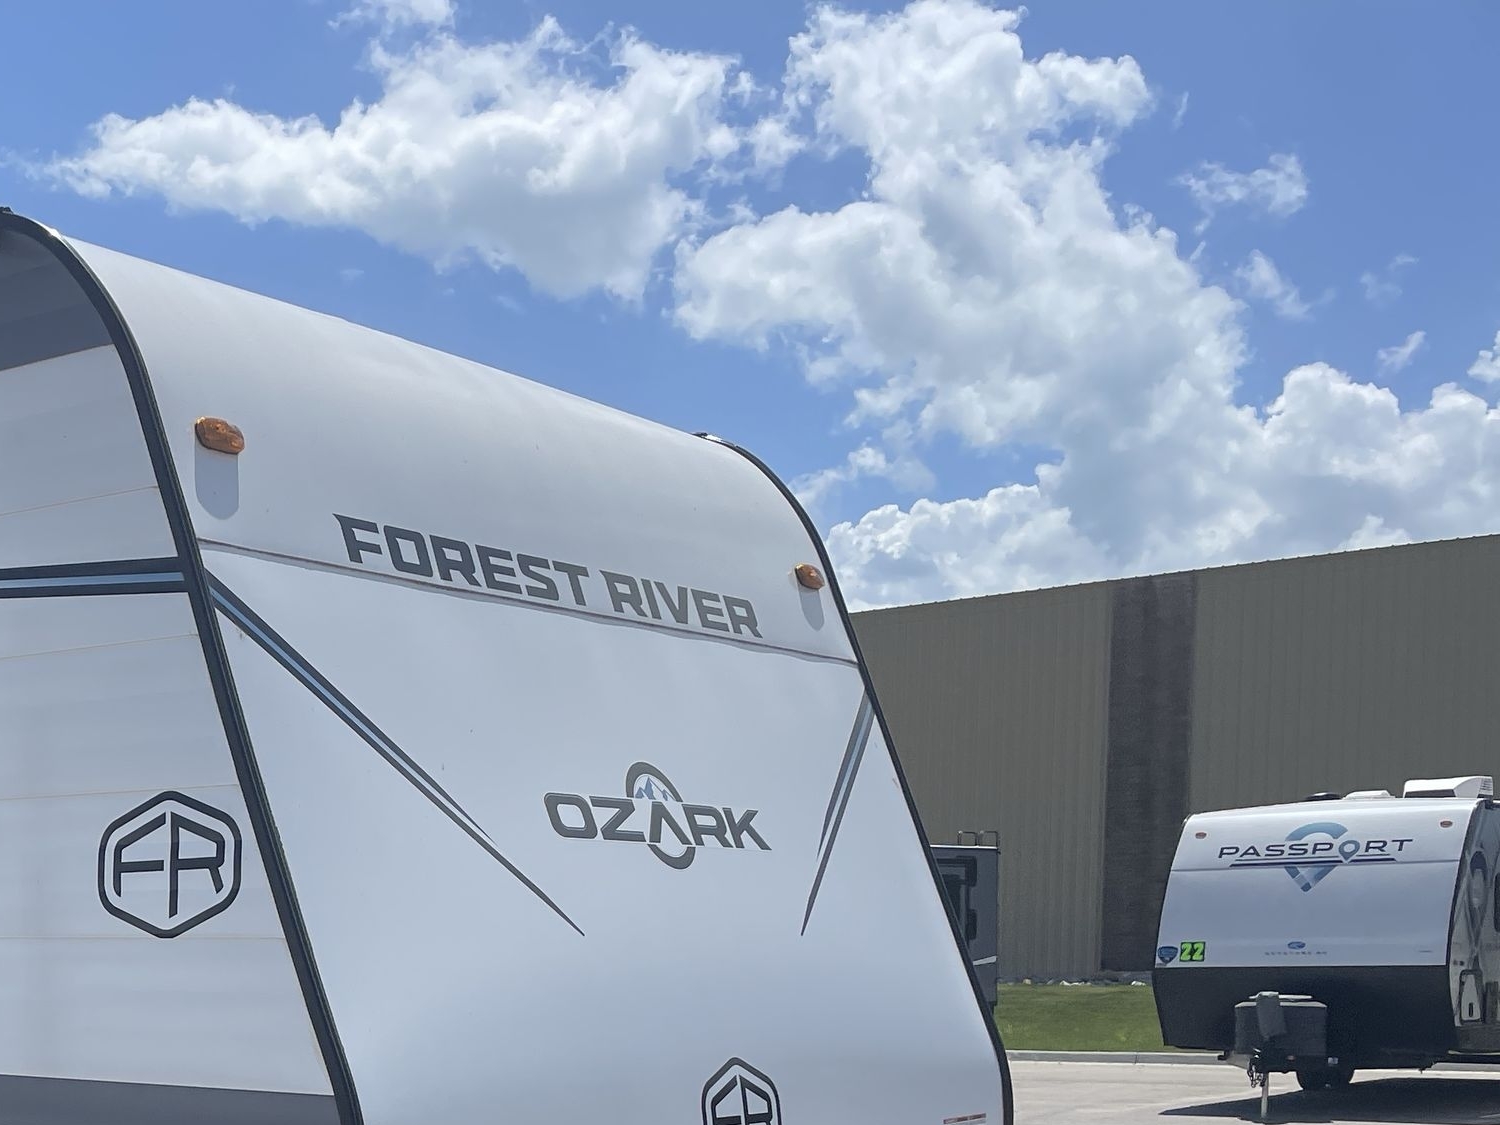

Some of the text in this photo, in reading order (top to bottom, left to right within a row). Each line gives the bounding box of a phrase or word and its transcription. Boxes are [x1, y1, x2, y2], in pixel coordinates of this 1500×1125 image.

[333, 513, 763, 639] FOREST RIVER
[544, 791, 772, 851] OZARK
[1218, 838, 1414, 863] PASSPORT
[112, 811, 226, 919] FR
[1179, 941, 1206, 962] 22
